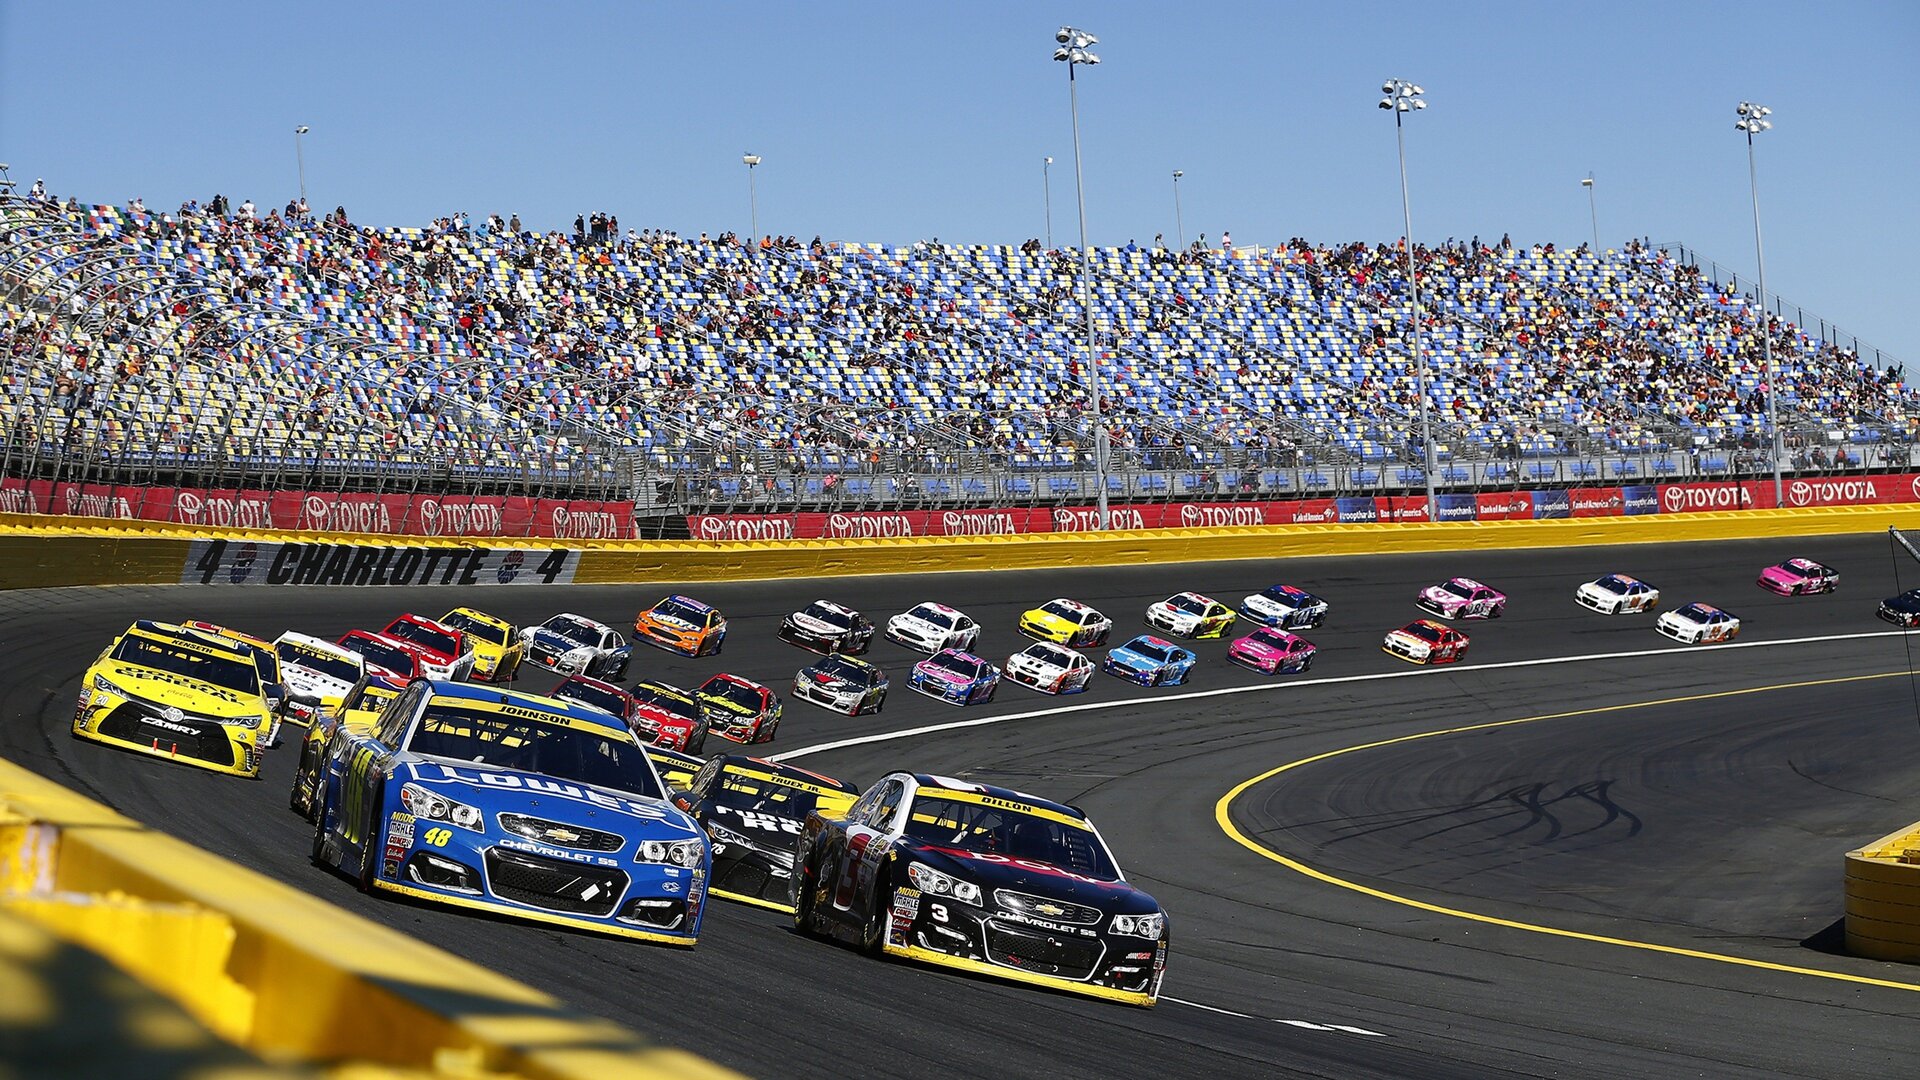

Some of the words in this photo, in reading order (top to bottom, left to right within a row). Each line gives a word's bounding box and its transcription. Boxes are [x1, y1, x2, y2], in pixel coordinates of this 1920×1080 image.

[1686, 487, 1752, 507] TOYOTA
[1812, 481, 1877, 500] TOYOTA
[200, 499, 273, 529] TOYOTA
[331, 502, 391, 532] TOYOTA
[443, 504, 502, 531] TOYOTA
[962, 513, 1015, 534] TOYOTA
[1201, 507, 1264, 527] TOYOTA
[571, 511, 618, 538] TOYOTA
[727, 518, 793, 540] TOYOTA
[852, 515, 913, 538] TOYOTA
[195, 540, 228, 584] 4
[267, 541, 490, 585] CHARLOTTE
[536, 548, 570, 584] 4
[172, 639, 213, 654] KENSETH
[96, 695, 109, 707] 20
[498, 705, 571, 726] JOHNSON
[140, 716, 201, 736] CAMRY
[666, 758, 697, 770] ELLIOTT
[438, 765, 668, 818] LOWE'S
[770, 776, 804, 788] TRUEX
[806, 785, 822, 794] JR.
[982, 797, 1032, 813] DILLON
[390, 821, 415, 835] MAHLE
[424, 827, 453, 847] 48
[499, 839, 594, 863] CHEVROLET
[598, 857, 618, 867] SS
[711, 842, 726, 855] 78
[897, 886, 922, 898] MOOG
[895, 896, 918, 909] MAHLE
[931, 903, 949, 922] 3
[996, 911, 1077, 934] CHEVROLET
[1080, 928, 1097, 937] SS
